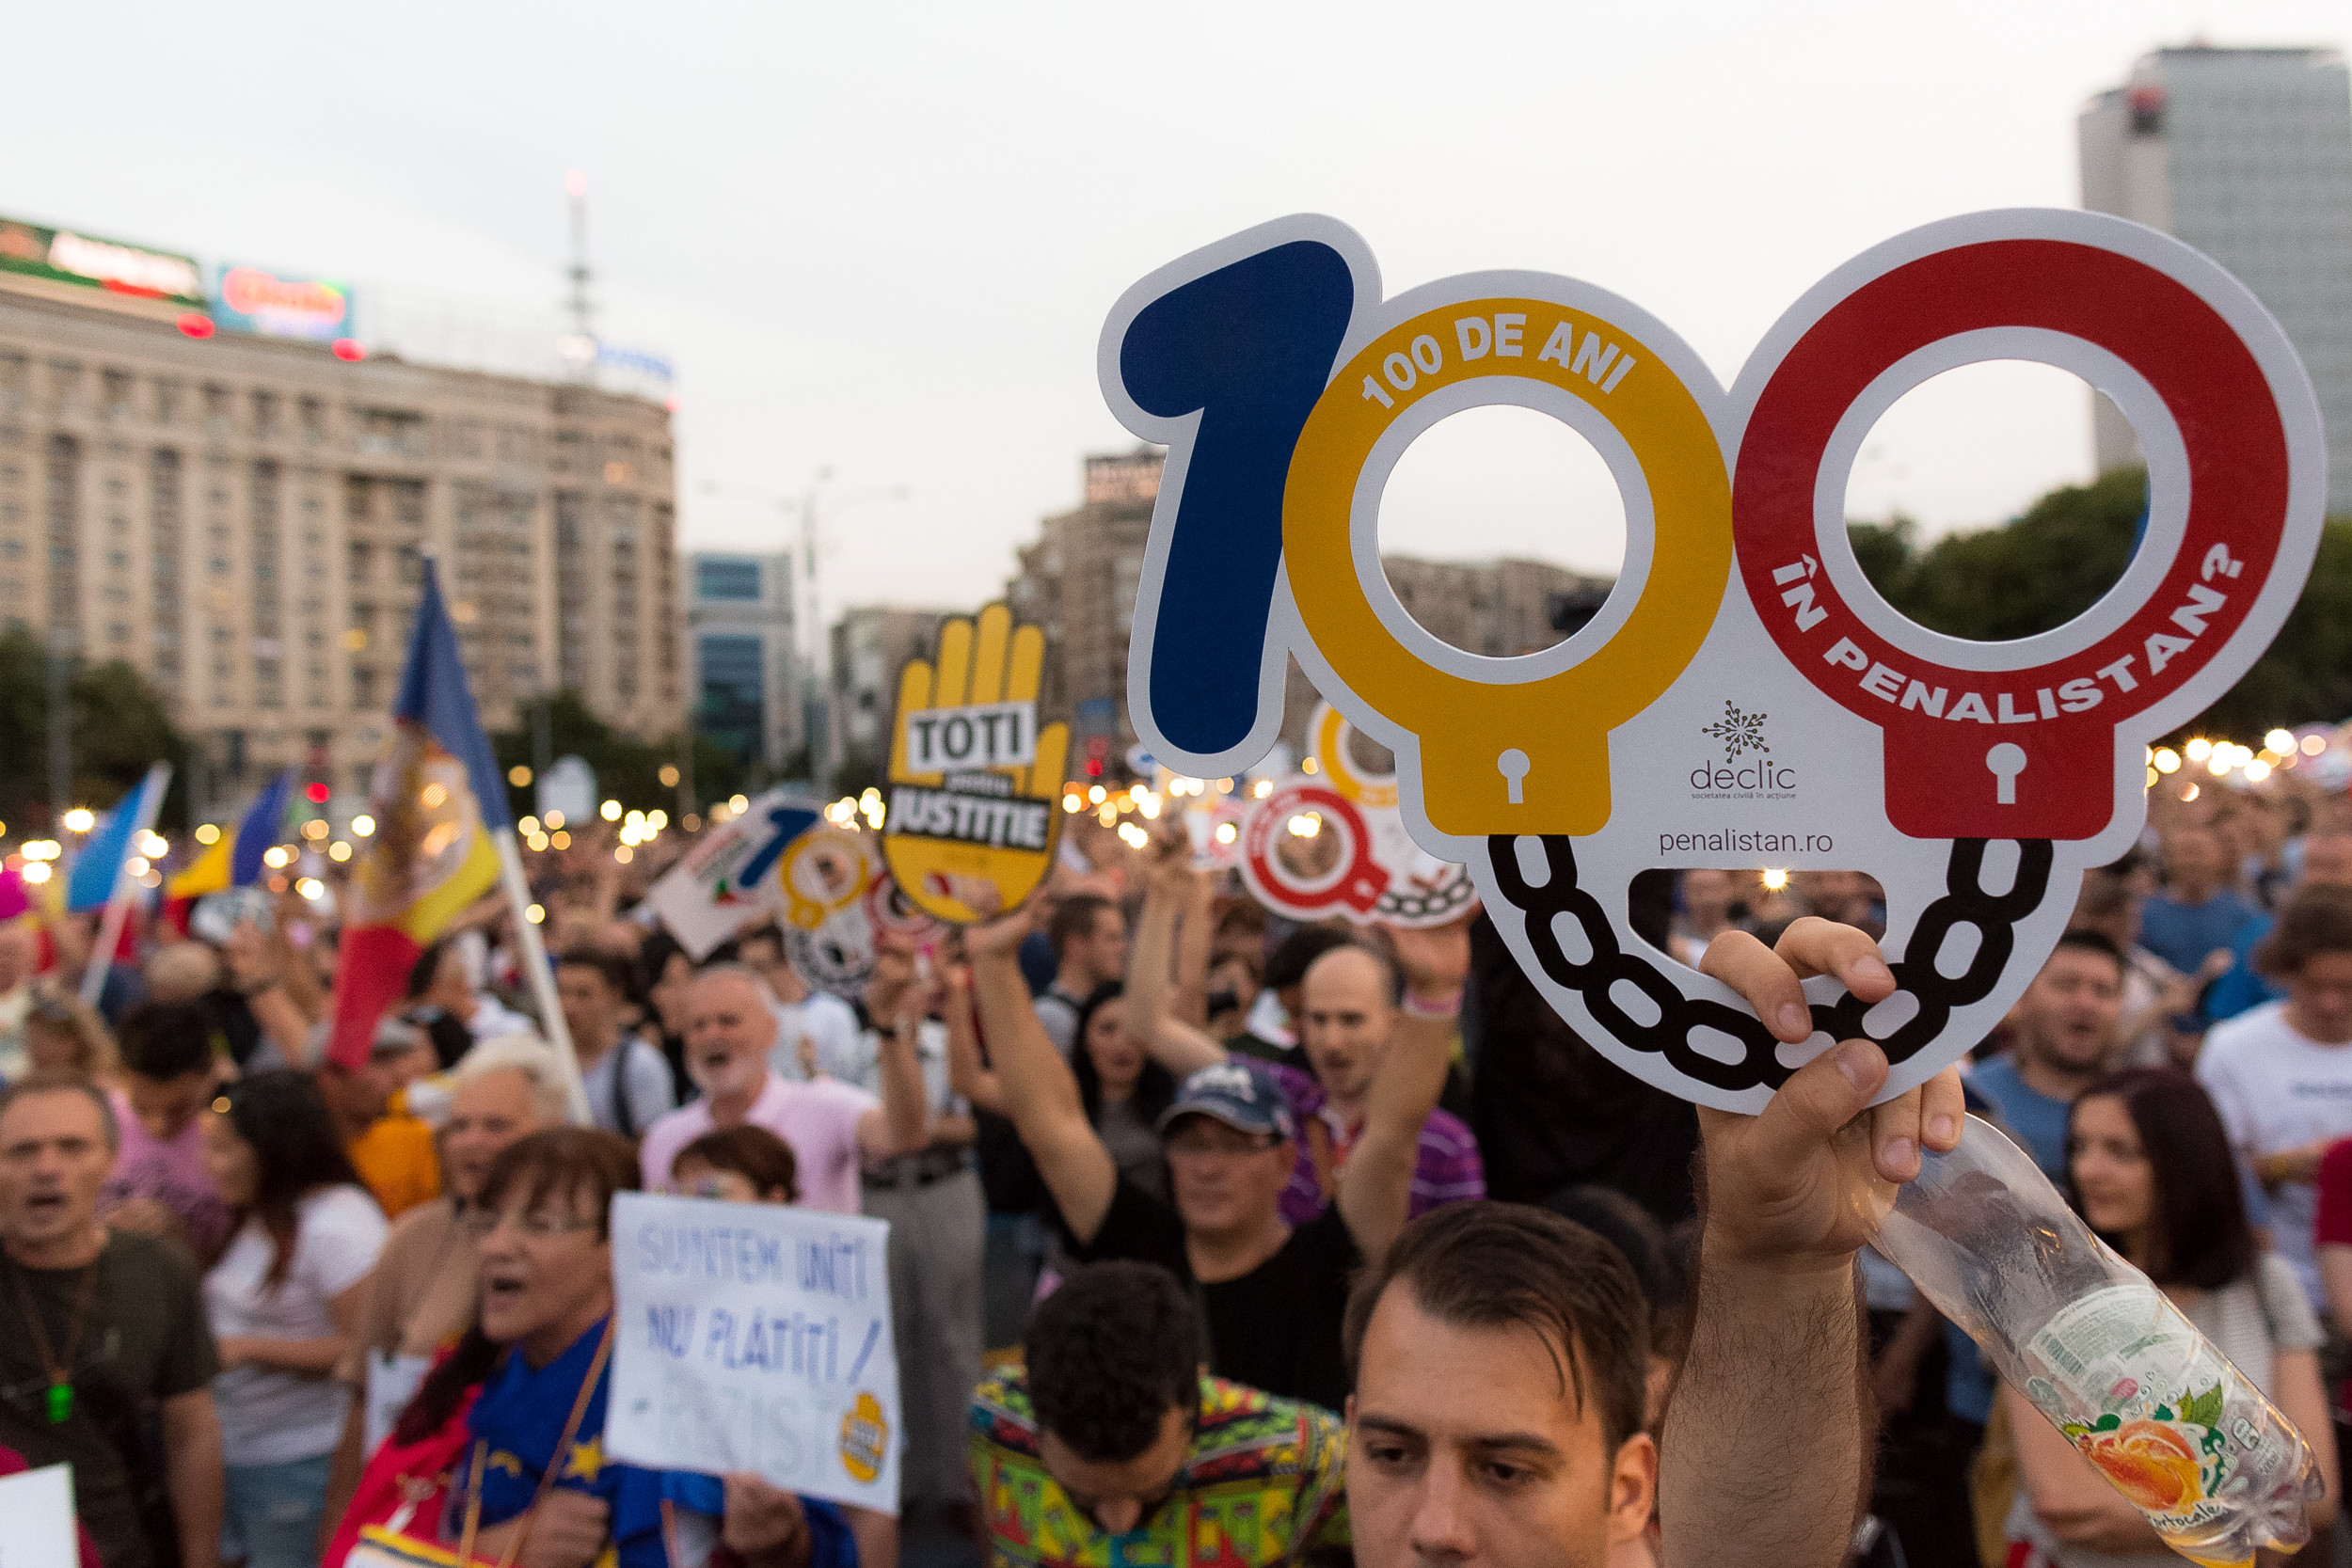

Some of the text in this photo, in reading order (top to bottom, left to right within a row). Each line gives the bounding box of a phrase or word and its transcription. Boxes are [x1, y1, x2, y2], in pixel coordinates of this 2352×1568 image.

[1361, 313, 1637, 409] 100 DE ANI
[1772, 542, 2244, 724] ÎN PENALISTAN?
[1690, 759, 1796, 789] declic
[1660, 828, 1834, 856] penalistan.ro
[645, 1304, 695, 1358] NU
